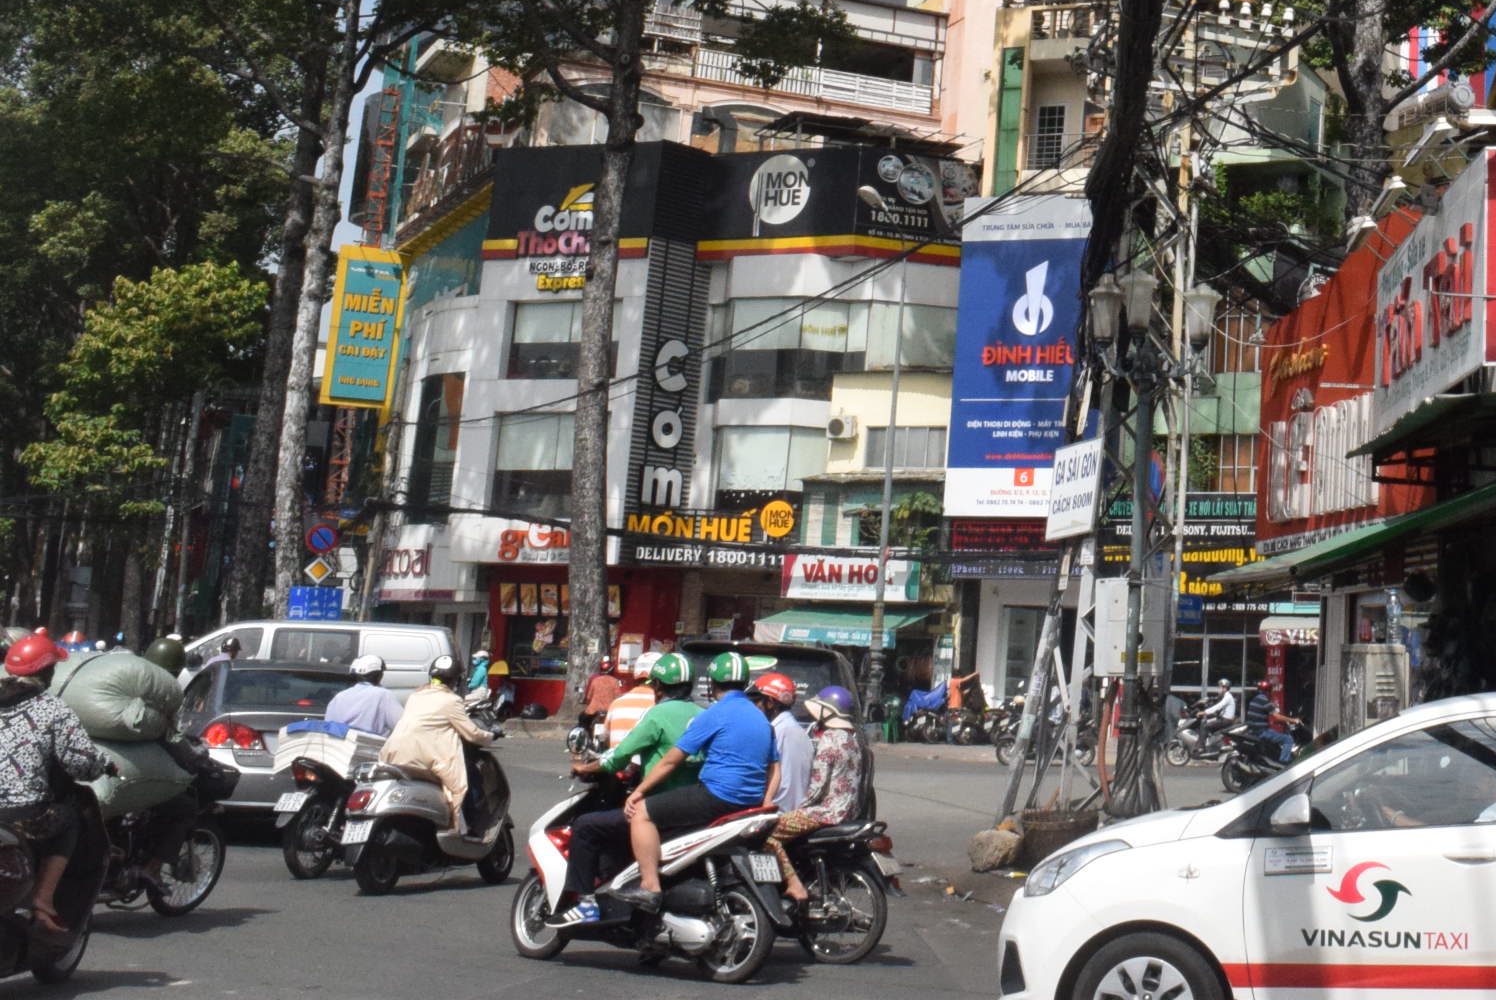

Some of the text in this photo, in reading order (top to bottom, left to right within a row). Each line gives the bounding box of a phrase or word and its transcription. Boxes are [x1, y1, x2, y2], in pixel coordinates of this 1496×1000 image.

[766, 170, 809, 189] MON
[764, 188, 802, 207] HUE
[349, 319, 388, 341] PHÍ
[982, 340, 1033, 366] ĐÌNH
[1005, 369, 1055, 382] MOBILE
[1055, 460, 1066, 486] GA
[1080, 444, 1098, 478] GÒN
[1019, 471, 1029, 484] 6
[1052, 494, 1071, 515] CÁCH
[628, 508, 757, 543] MÓN HUẾ
[768, 518, 790, 529] HUE
[636, 546, 701, 563] DELIVERY
[802, 559, 842, 584] VĂN
